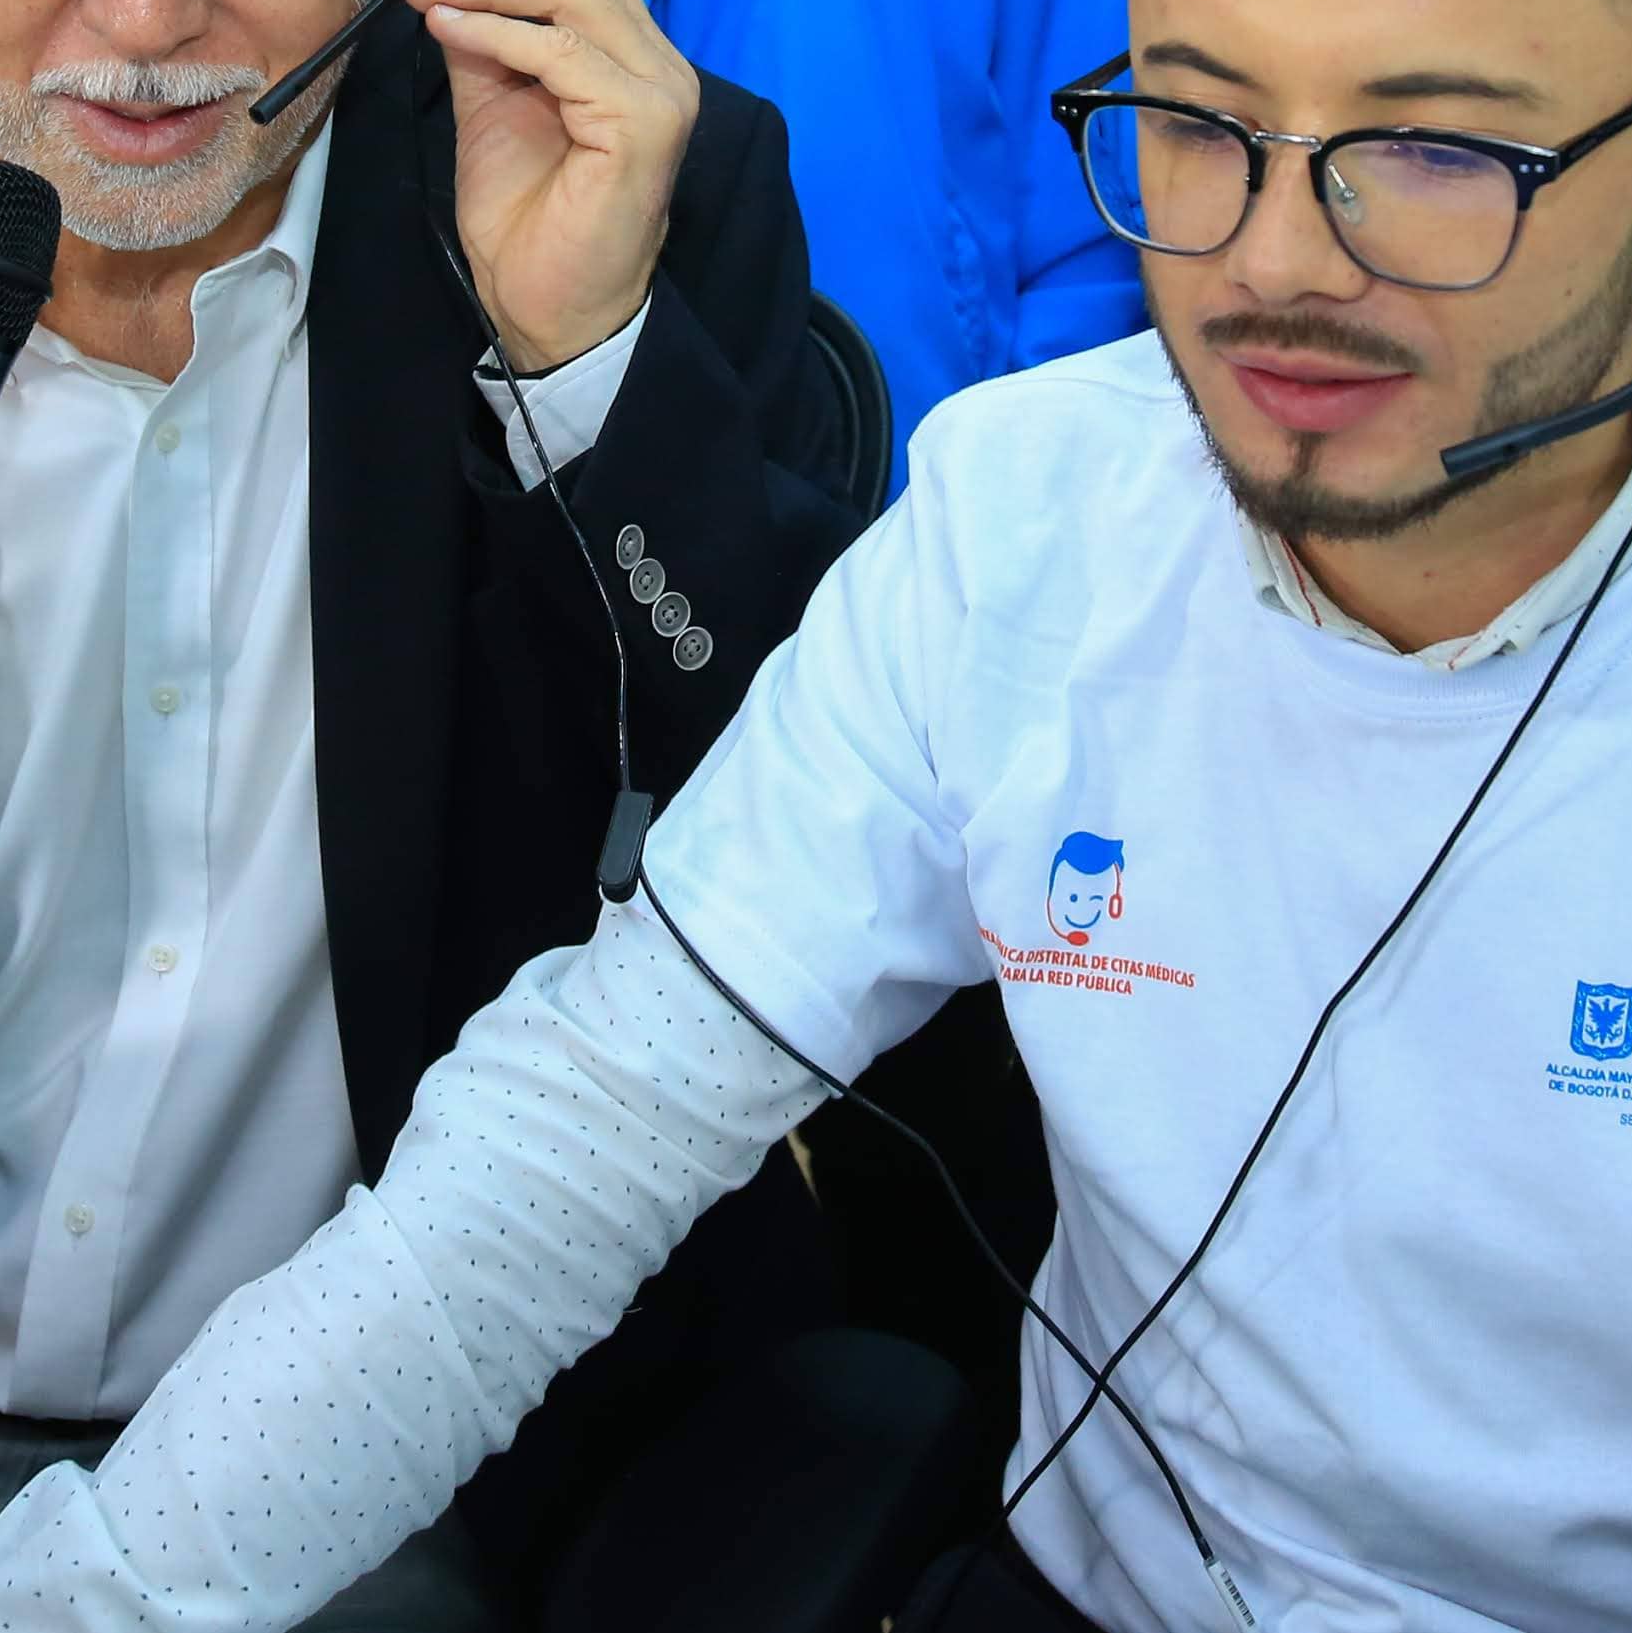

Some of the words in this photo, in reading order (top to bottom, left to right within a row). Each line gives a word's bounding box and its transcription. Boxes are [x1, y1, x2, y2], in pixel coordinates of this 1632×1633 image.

[1026, 949, 1088, 969] DISTRITAL
[1091, 955, 1109, 971] DE
[1111, 958, 1144, 977] CITAS
[1145, 961, 1196, 988] MÉDICAS
[1028, 967, 1045, 983] LA
[1047, 969, 1074, 986] RED
[1076, 972, 1133, 995] PÚBLICA
[1546, 1063, 1607, 1082] ALCALDÍA
[1548, 1079, 1566, 1092] DE
[1567, 1081, 1619, 1098] BOGOTÁ
